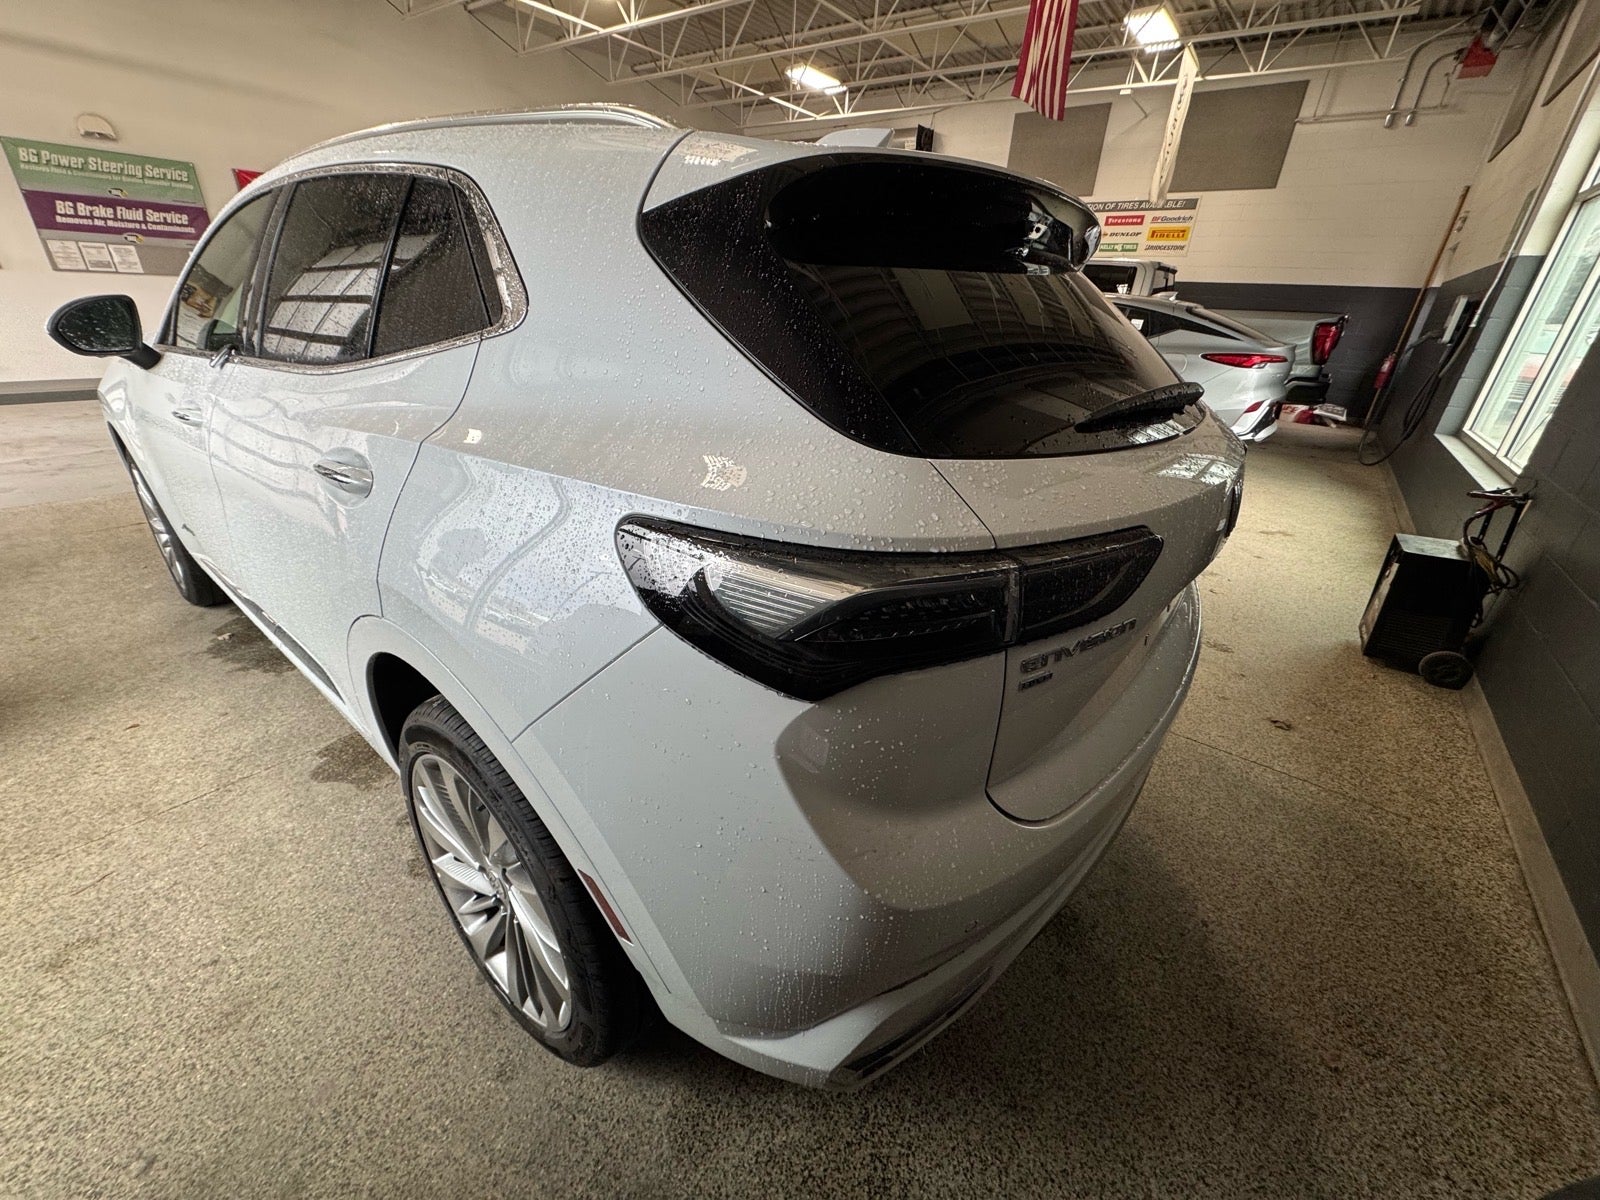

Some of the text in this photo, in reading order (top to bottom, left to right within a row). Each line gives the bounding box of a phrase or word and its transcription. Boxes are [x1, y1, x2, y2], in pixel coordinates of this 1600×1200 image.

[19, 148, 38, 163] BG
[41, 150, 85, 169] Power
[88, 157, 143, 179] Steering
[145, 164, 189, 182] Service
[55, 200, 189, 225] BG Brake Fluid Service
[1105, 202, 1117, 210] OF
[1117, 201, 1139, 209] TIRES
[55, 215, 93, 226] Removes
[107, 219, 140, 229] Moisture
[1151, 229, 1187, 239] PIRELLI
